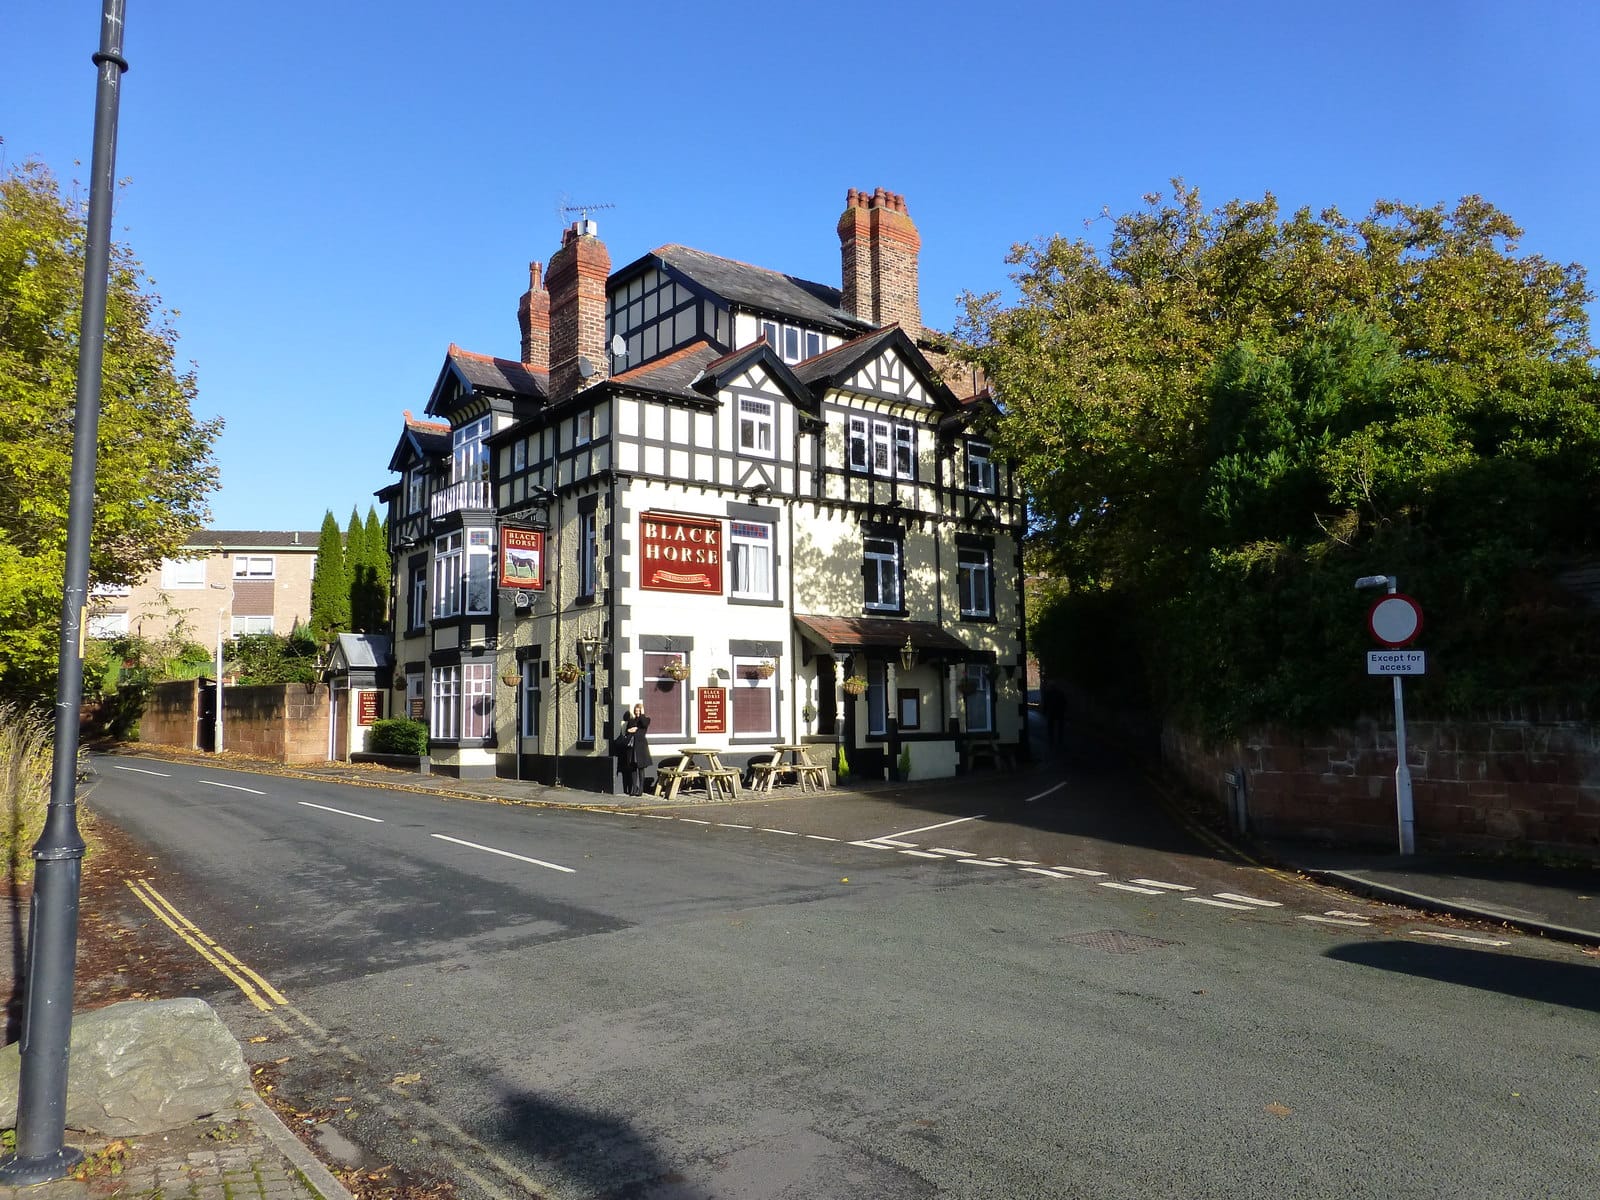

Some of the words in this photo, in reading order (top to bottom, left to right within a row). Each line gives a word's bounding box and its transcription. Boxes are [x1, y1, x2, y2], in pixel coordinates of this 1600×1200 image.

[509, 532, 536, 541] BLACK
[645, 522, 718, 544] BLACK
[509, 539, 536, 547] HORSE
[646, 544, 718, 564] HORSE
[1371, 654, 1403, 662] Except
